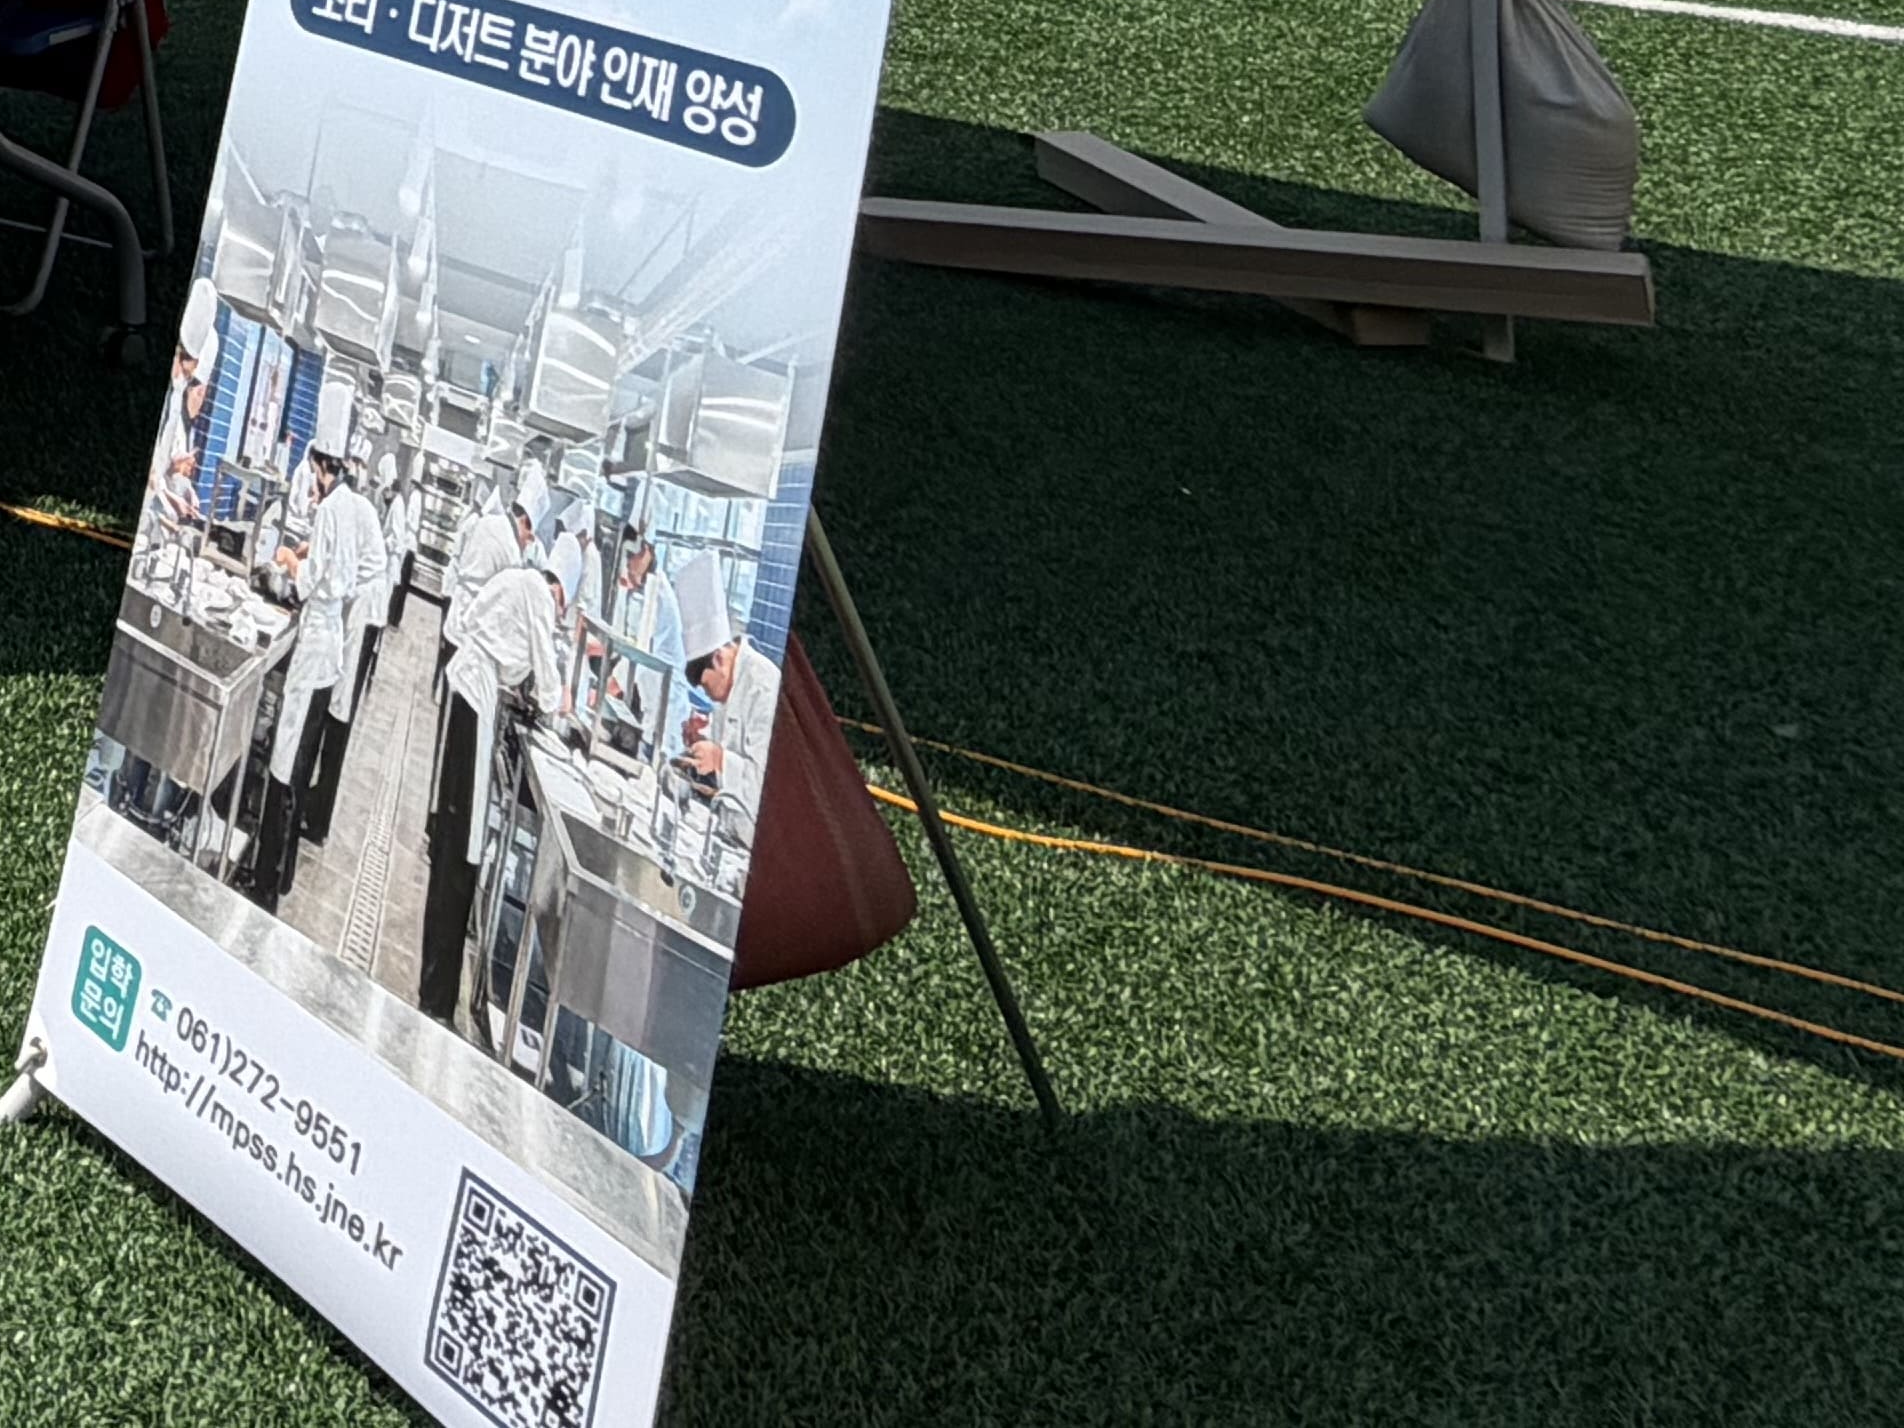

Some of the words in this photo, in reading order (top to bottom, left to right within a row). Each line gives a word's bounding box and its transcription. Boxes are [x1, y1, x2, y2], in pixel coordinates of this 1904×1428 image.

[523, 24, 595, 99] 분야
[600, 47, 674, 122] 인재
[683, 69, 764, 145] 양성
[79, 979, 124, 1041] 문의
[89, 938, 133, 999] 입학
[136, 1030, 403, 1271] http://mpss.hs.jne.kr
[177, 1007, 362, 1176] 061)272-9551
